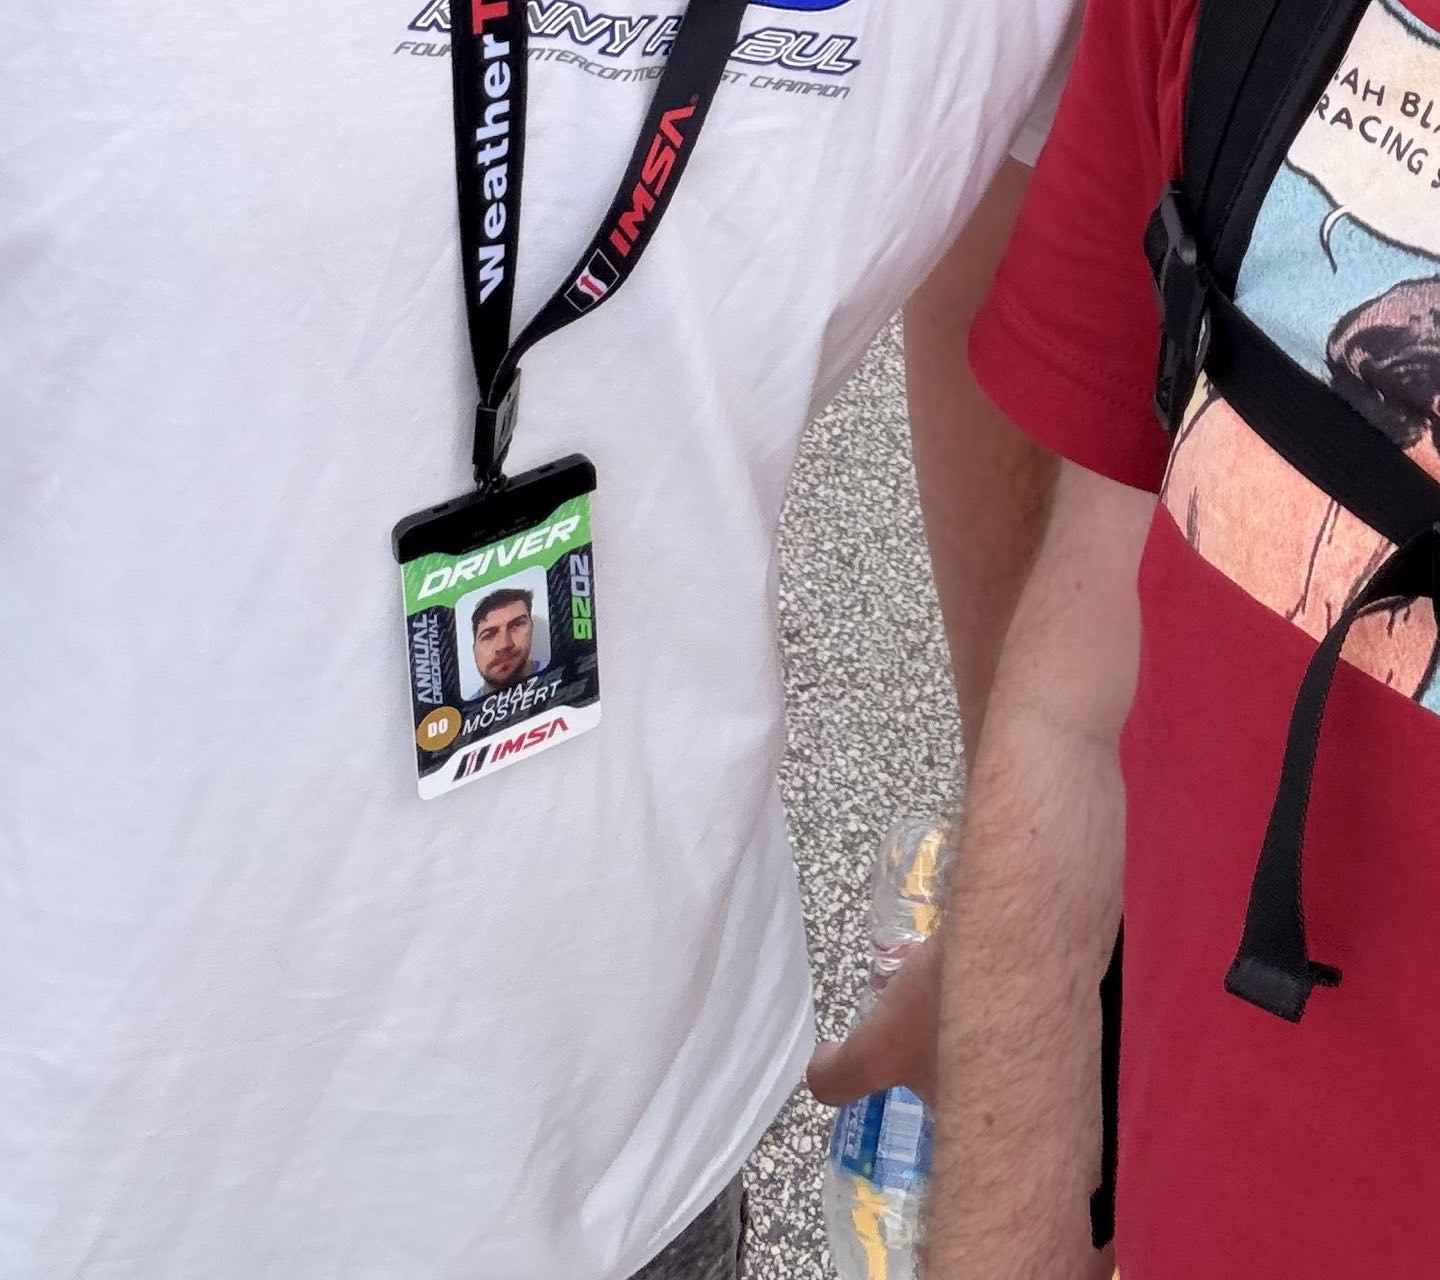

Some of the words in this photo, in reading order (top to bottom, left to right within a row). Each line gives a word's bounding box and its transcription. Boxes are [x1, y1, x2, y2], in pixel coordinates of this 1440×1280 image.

[749, 74, 852, 100] CHAMPION
[1334, 67, 1386, 107] AH
[1314, 93, 1430, 176] RACING
[610, 100, 698, 258] IMSA
[417, 514, 581, 601] DRIVER
[412, 613, 434, 704] ANNUAL
[428, 613, 444, 705] CREDENTIAL
[482, 675, 539, 712] CHAZ
[462, 679, 563, 737] MOSTERT
[490, 716, 569, 764] IMSA
